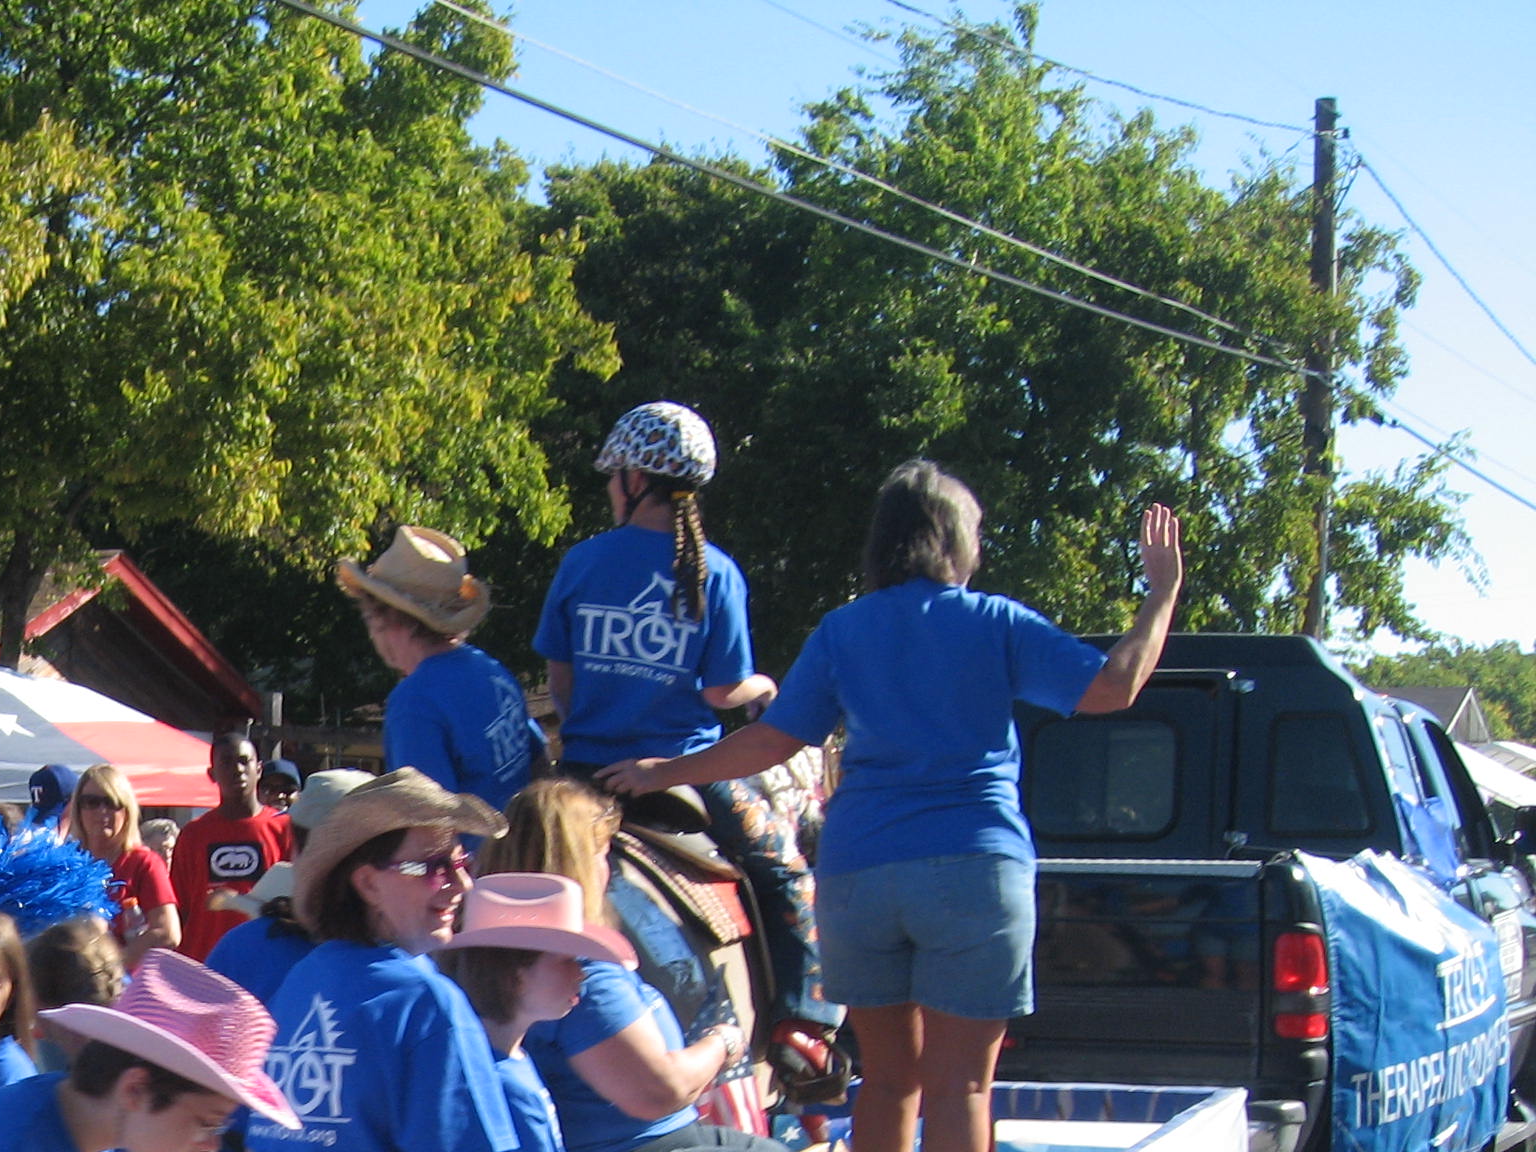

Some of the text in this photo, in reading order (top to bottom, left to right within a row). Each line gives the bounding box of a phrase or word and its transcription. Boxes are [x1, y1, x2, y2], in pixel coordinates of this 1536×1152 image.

[575, 607, 699, 666] TROT
[31, 786, 43, 803] T
[267, 1050, 357, 1118] ROT
